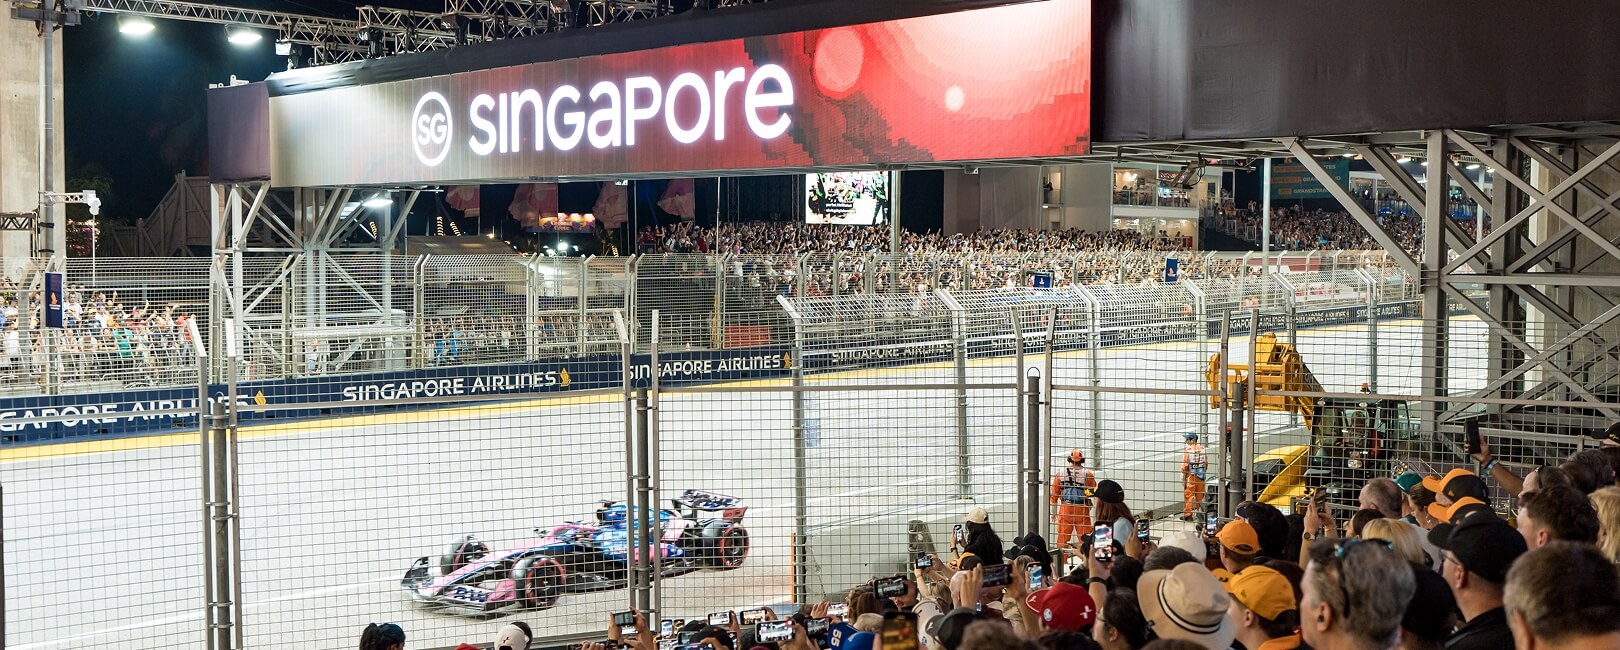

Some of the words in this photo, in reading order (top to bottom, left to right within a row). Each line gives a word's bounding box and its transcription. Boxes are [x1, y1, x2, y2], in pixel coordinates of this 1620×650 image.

[417, 112, 448, 145] SG
[717, 354, 781, 373] AIRLINES
[343, 378, 464, 402] SINGAPORE
[471, 370, 557, 393] AIRLINES
[0, 403, 118, 431] GAPORE
[830, 628, 842, 648] 55
